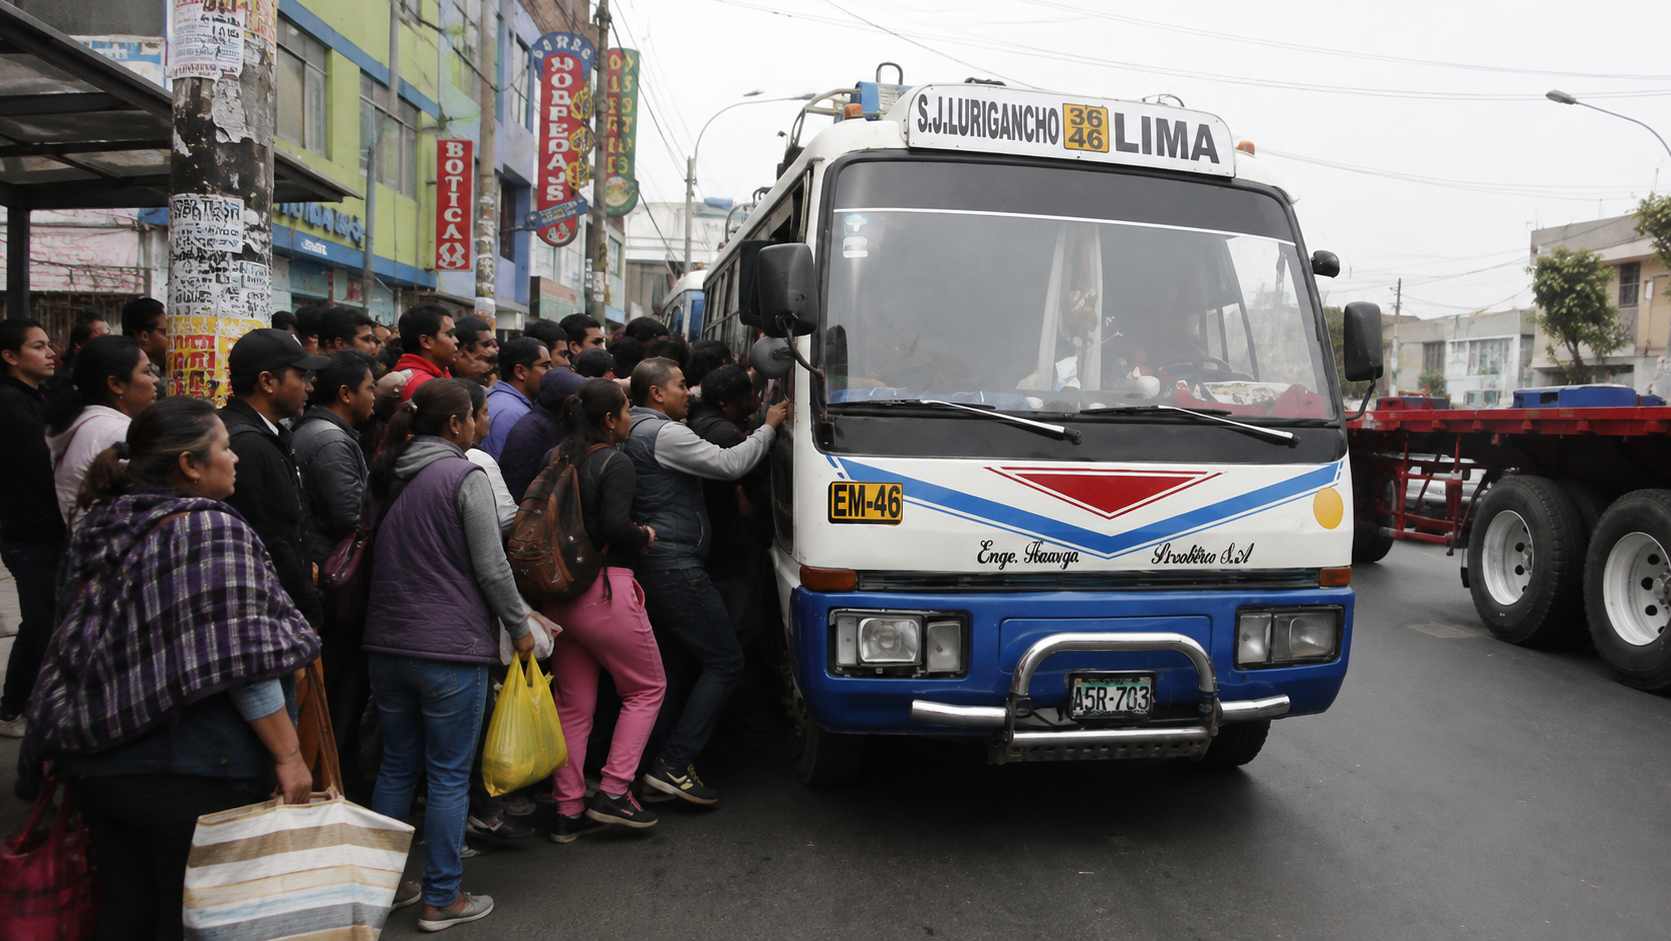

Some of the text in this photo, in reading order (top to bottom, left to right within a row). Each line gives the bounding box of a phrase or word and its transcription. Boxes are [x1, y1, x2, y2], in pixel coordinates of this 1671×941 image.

[917, 94, 1060, 145] S.J.LURIGANCHO
[1069, 107, 1103, 128] 36
[1068, 128, 1104, 149] 46
[1114, 112, 1220, 164] LIMA
[442, 142, 464, 239] BOTICA
[834, 484, 901, 518] EM-46
[1073, 686, 1150, 711] A5R-703
